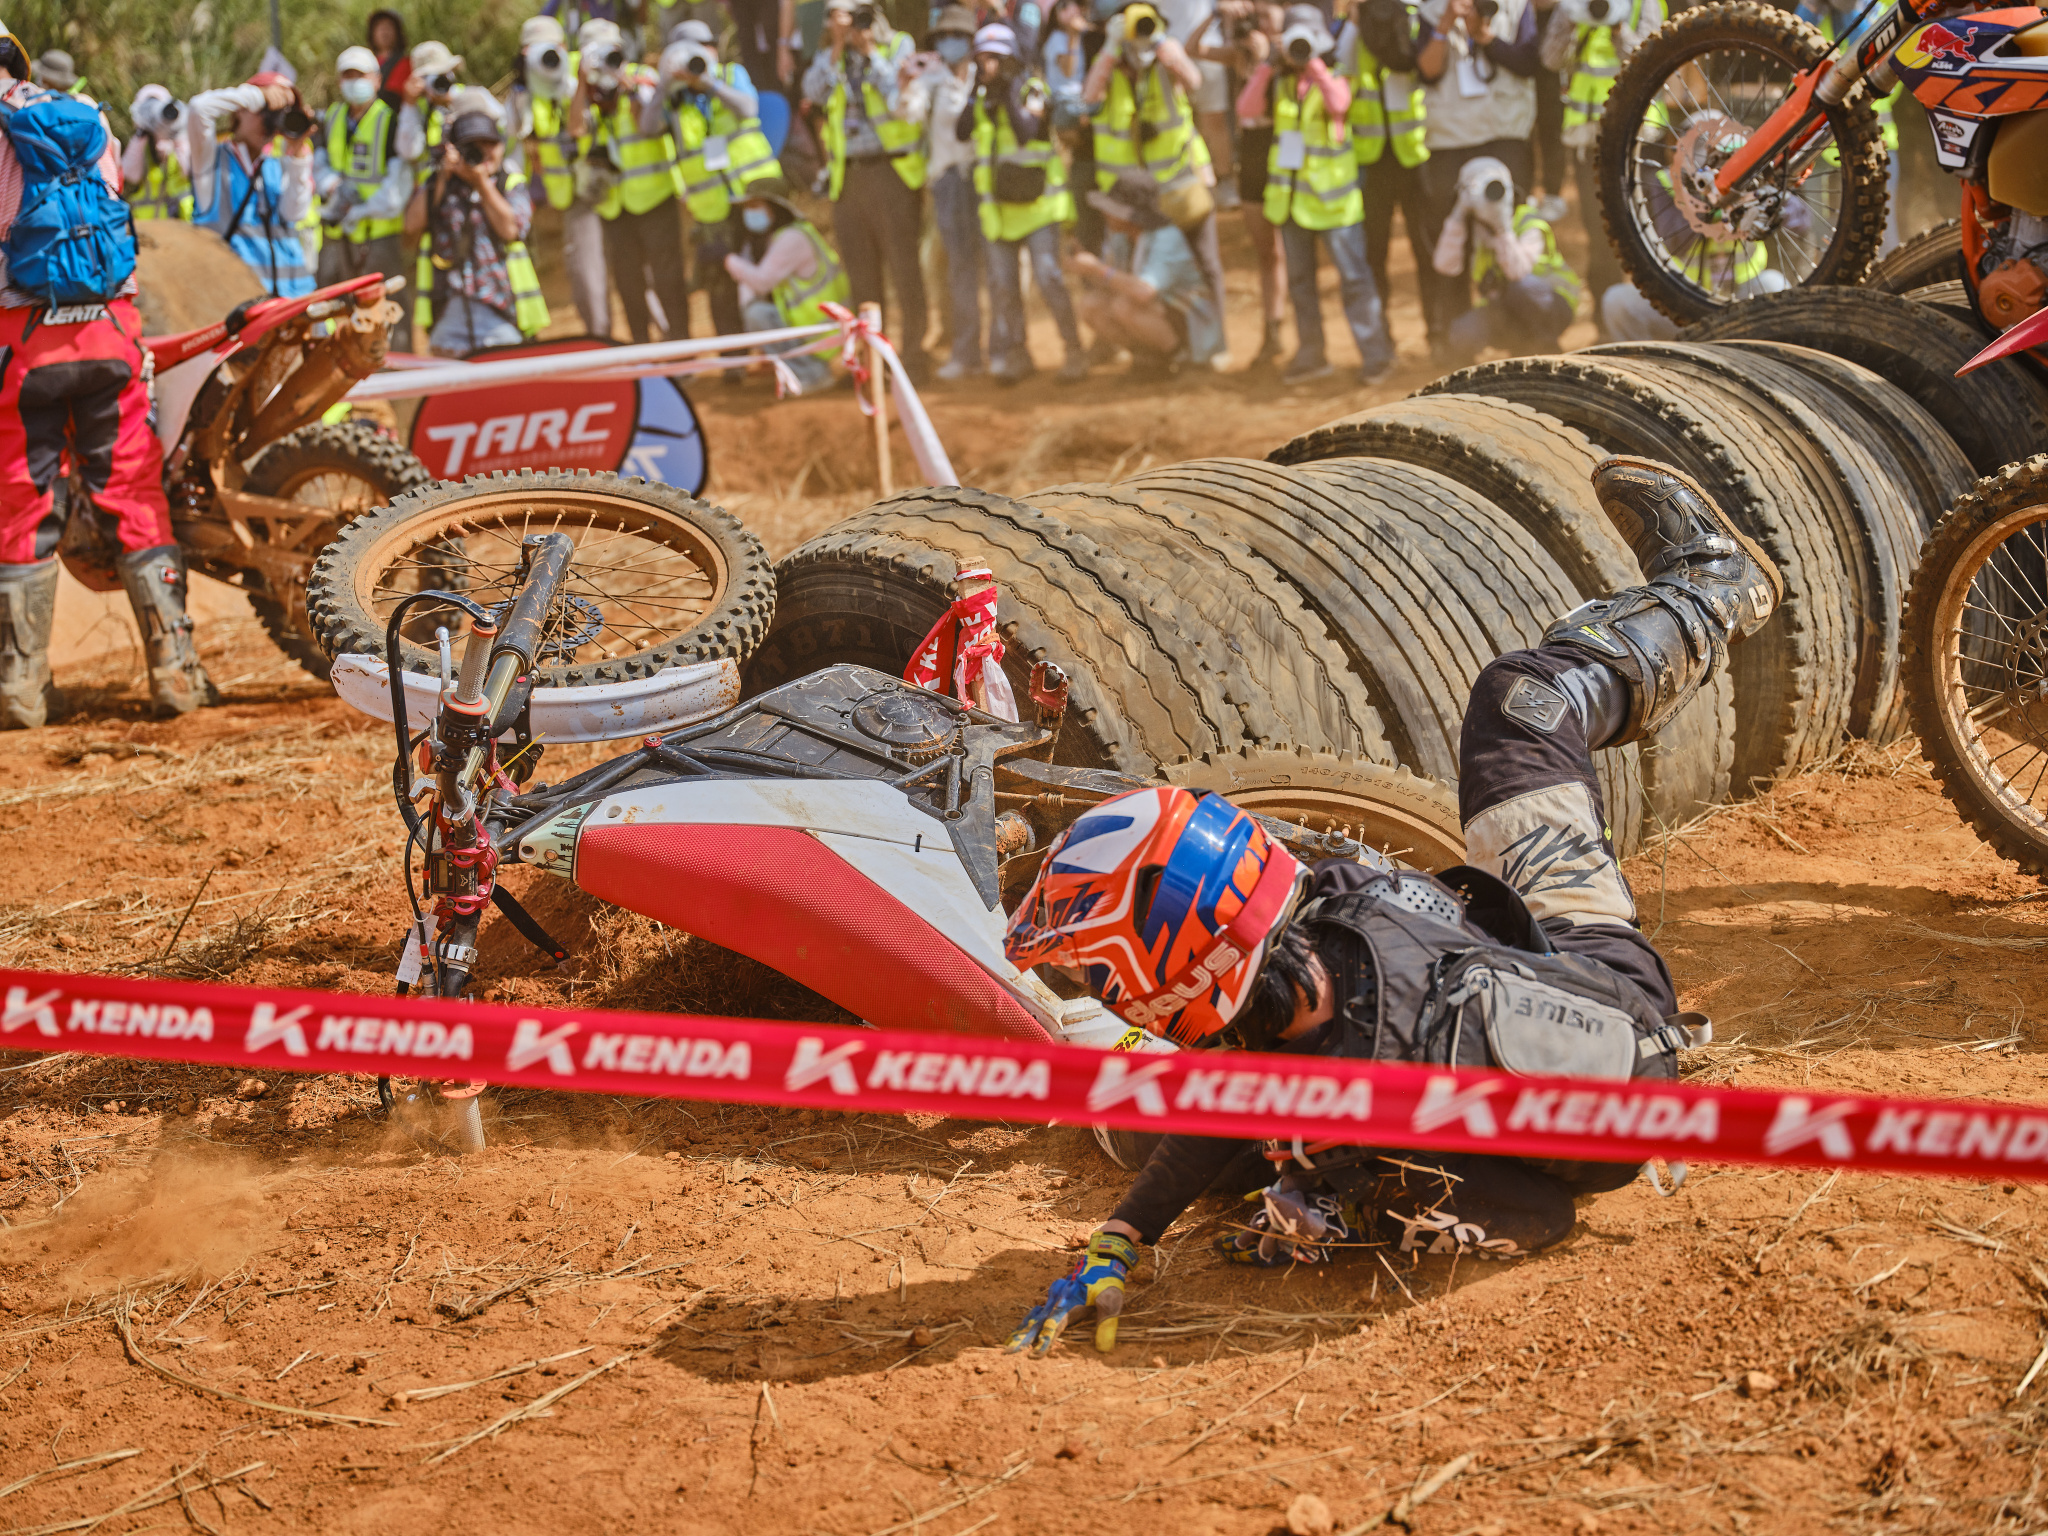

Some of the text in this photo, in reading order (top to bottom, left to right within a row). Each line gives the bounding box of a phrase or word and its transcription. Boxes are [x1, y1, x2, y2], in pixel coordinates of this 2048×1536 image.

[1912, 69, 2048, 116] KT
[426, 402, 617, 476] TARC
[67, 1000, 214, 1041] KENDA
[317, 1016, 474, 1060] KENDA
[583, 1033, 752, 1080] KENDA
[868, 1051, 1051, 1099] KENDA
[1176, 1070, 1373, 1120] KENDA
[1508, 1088, 1720, 1142] KENDA
[1867, 1108, 2048, 1163] KEND
